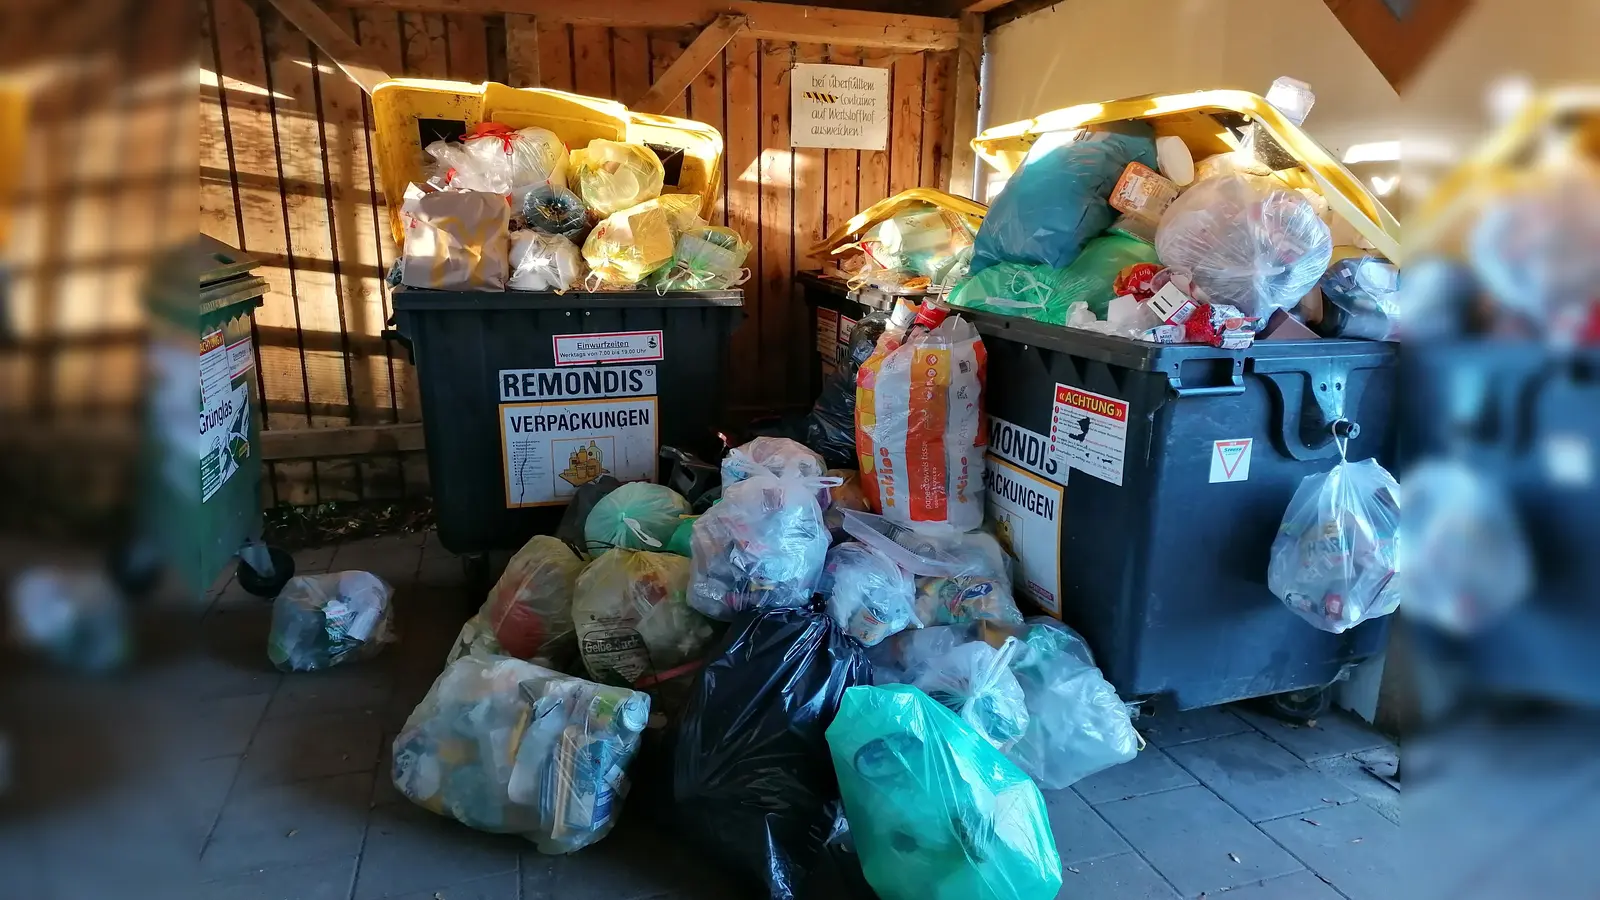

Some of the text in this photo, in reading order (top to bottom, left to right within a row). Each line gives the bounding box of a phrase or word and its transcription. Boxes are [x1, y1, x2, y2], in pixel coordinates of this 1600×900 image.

[811, 74, 875, 91] bei überfülltem
[840, 93, 877, 106] Container
[811, 108, 828, 120] auf
[577, 340, 629, 350] Einwurfzeiten
[559, 350, 586, 358] Werktags
[510, 409, 649, 433] VERPACKUNGEN
[585, 641, 612, 653] Gelbe
